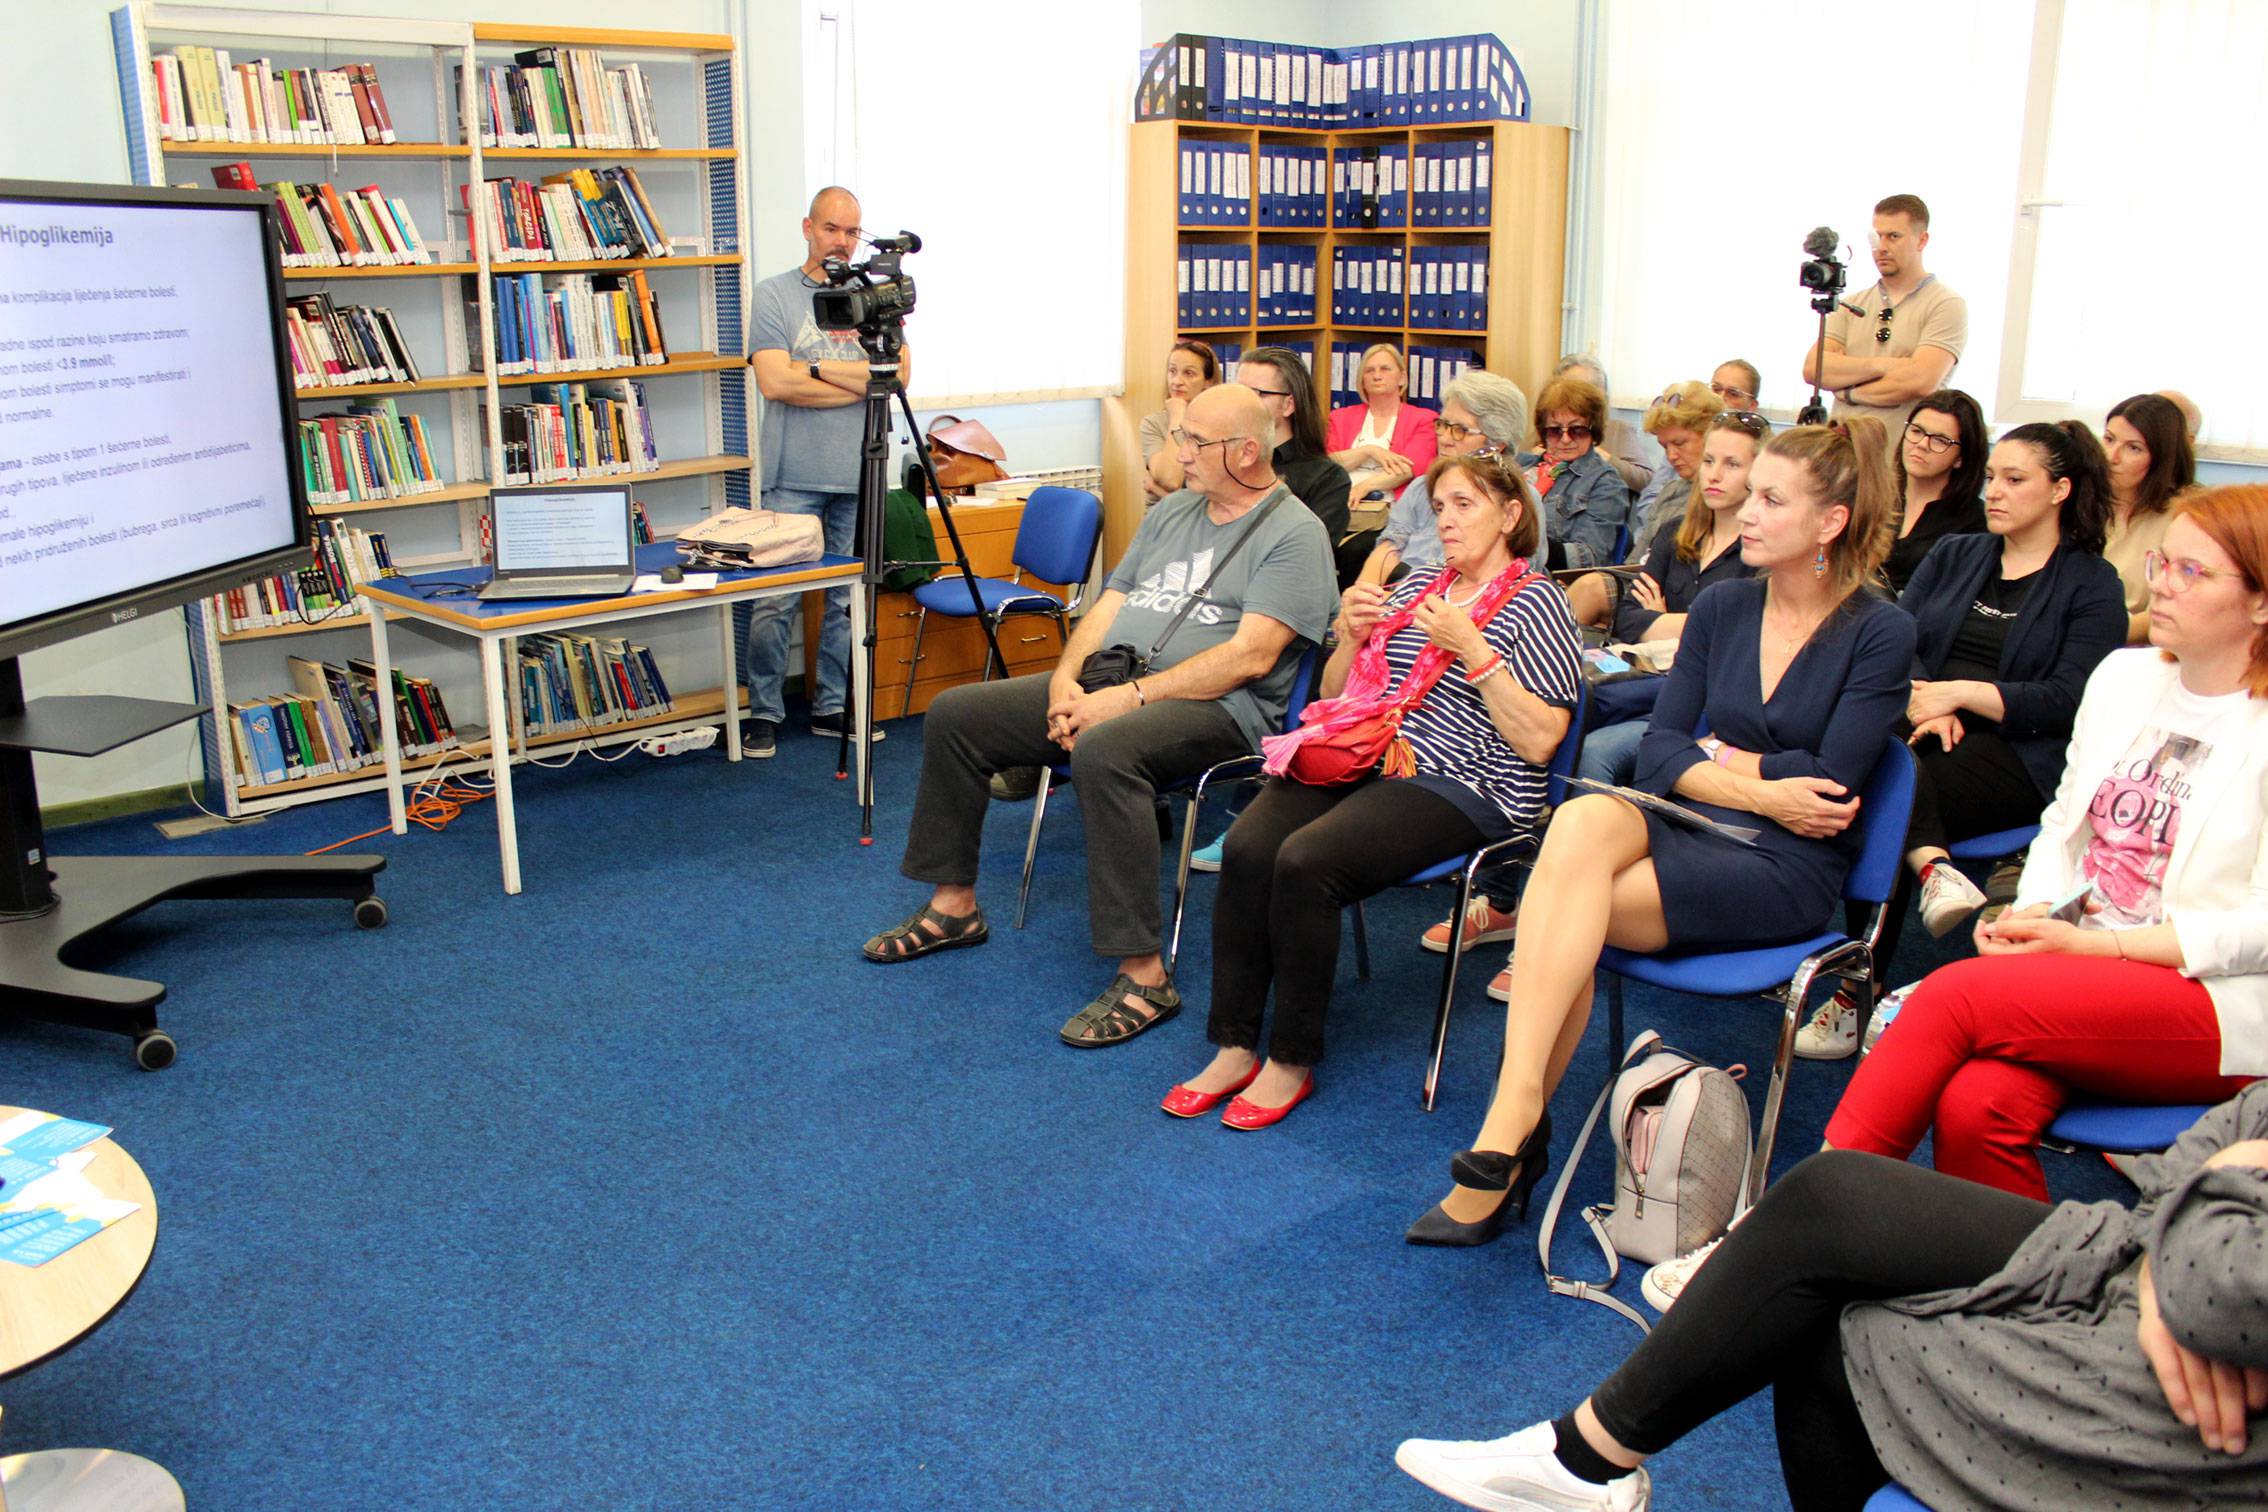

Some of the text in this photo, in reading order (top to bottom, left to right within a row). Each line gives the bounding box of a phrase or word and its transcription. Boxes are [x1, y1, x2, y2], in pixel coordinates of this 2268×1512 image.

[0, 225, 114, 247] Hipoglikemija
[56, 336, 86, 348] razine
[108, 331, 151, 343] smatramo
[98, 379, 110, 389] se
[111, 376, 136, 389] mogu
[31, 452, 61, 466] osobe
[71, 446, 97, 460] tipom
[99, 461, 140, 478] inzulinom
[160, 517, 178, 530] srca
